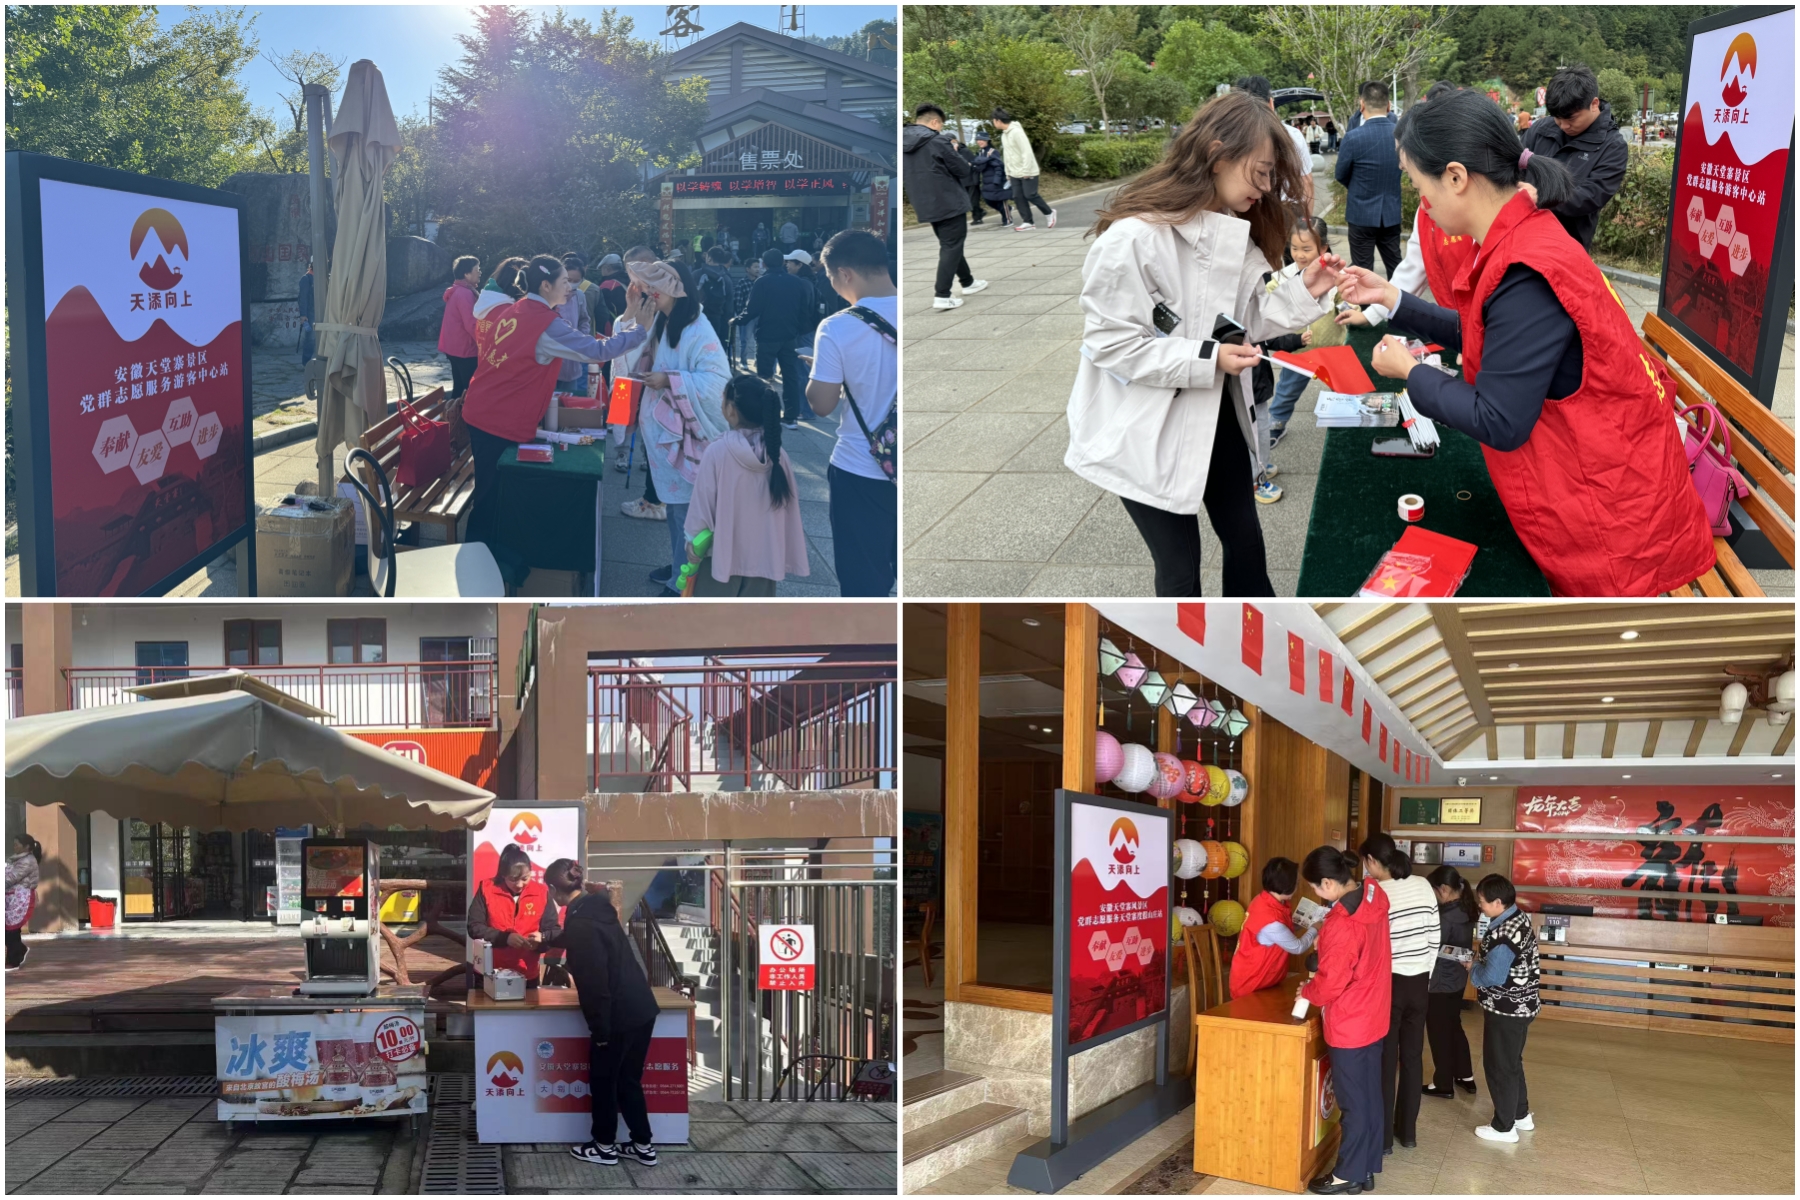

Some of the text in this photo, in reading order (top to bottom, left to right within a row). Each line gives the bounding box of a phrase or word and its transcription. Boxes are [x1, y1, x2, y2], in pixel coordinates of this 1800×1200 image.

[1713, 108, 1750, 124] 天添向上
[739, 150, 804, 171] 售票处
[1700, 161, 1750, 184] 安徽天堂寨景区
[729, 180, 777, 191] 以学增智
[784, 178, 835, 191] 以学正风
[1686, 173, 1766, 206] 党群志愿服务游客中心站
[1689, 207, 1703, 223] 奉献
[1718, 218, 1733, 236] 互助
[1701, 229, 1714, 247] 友爱
[1731, 243, 1749, 262] 进步
[130, 290, 193, 312] 天添向上
[114, 349, 208, 384] 安徽天堂寨景区
[80, 361, 229, 415] 党群志愿服务游客中心站
[167, 410, 192, 434] 互助
[197, 423, 219, 446] 进步
[100, 430, 131, 458] 奉献
[136, 441, 164, 469] 友爱
[1523, 795, 1582, 817] 龙年大吉
[1458, 849, 1466, 857] B
[1108, 864, 1140, 875] 天添向上
[1099, 901, 1148, 913] 安徽天堂寨风景区
[1092, 940, 1107, 952] 奉献
[1126, 935, 1139, 946] 互助
[1109, 950, 1123, 961] 友爱
[1140, 945, 1152, 957] 进步
[225, 1031, 312, 1077] 冰爽
[539, 1062, 591, 1071] 安徽天堂寨景
[485, 1088, 525, 1097] 天添向上
